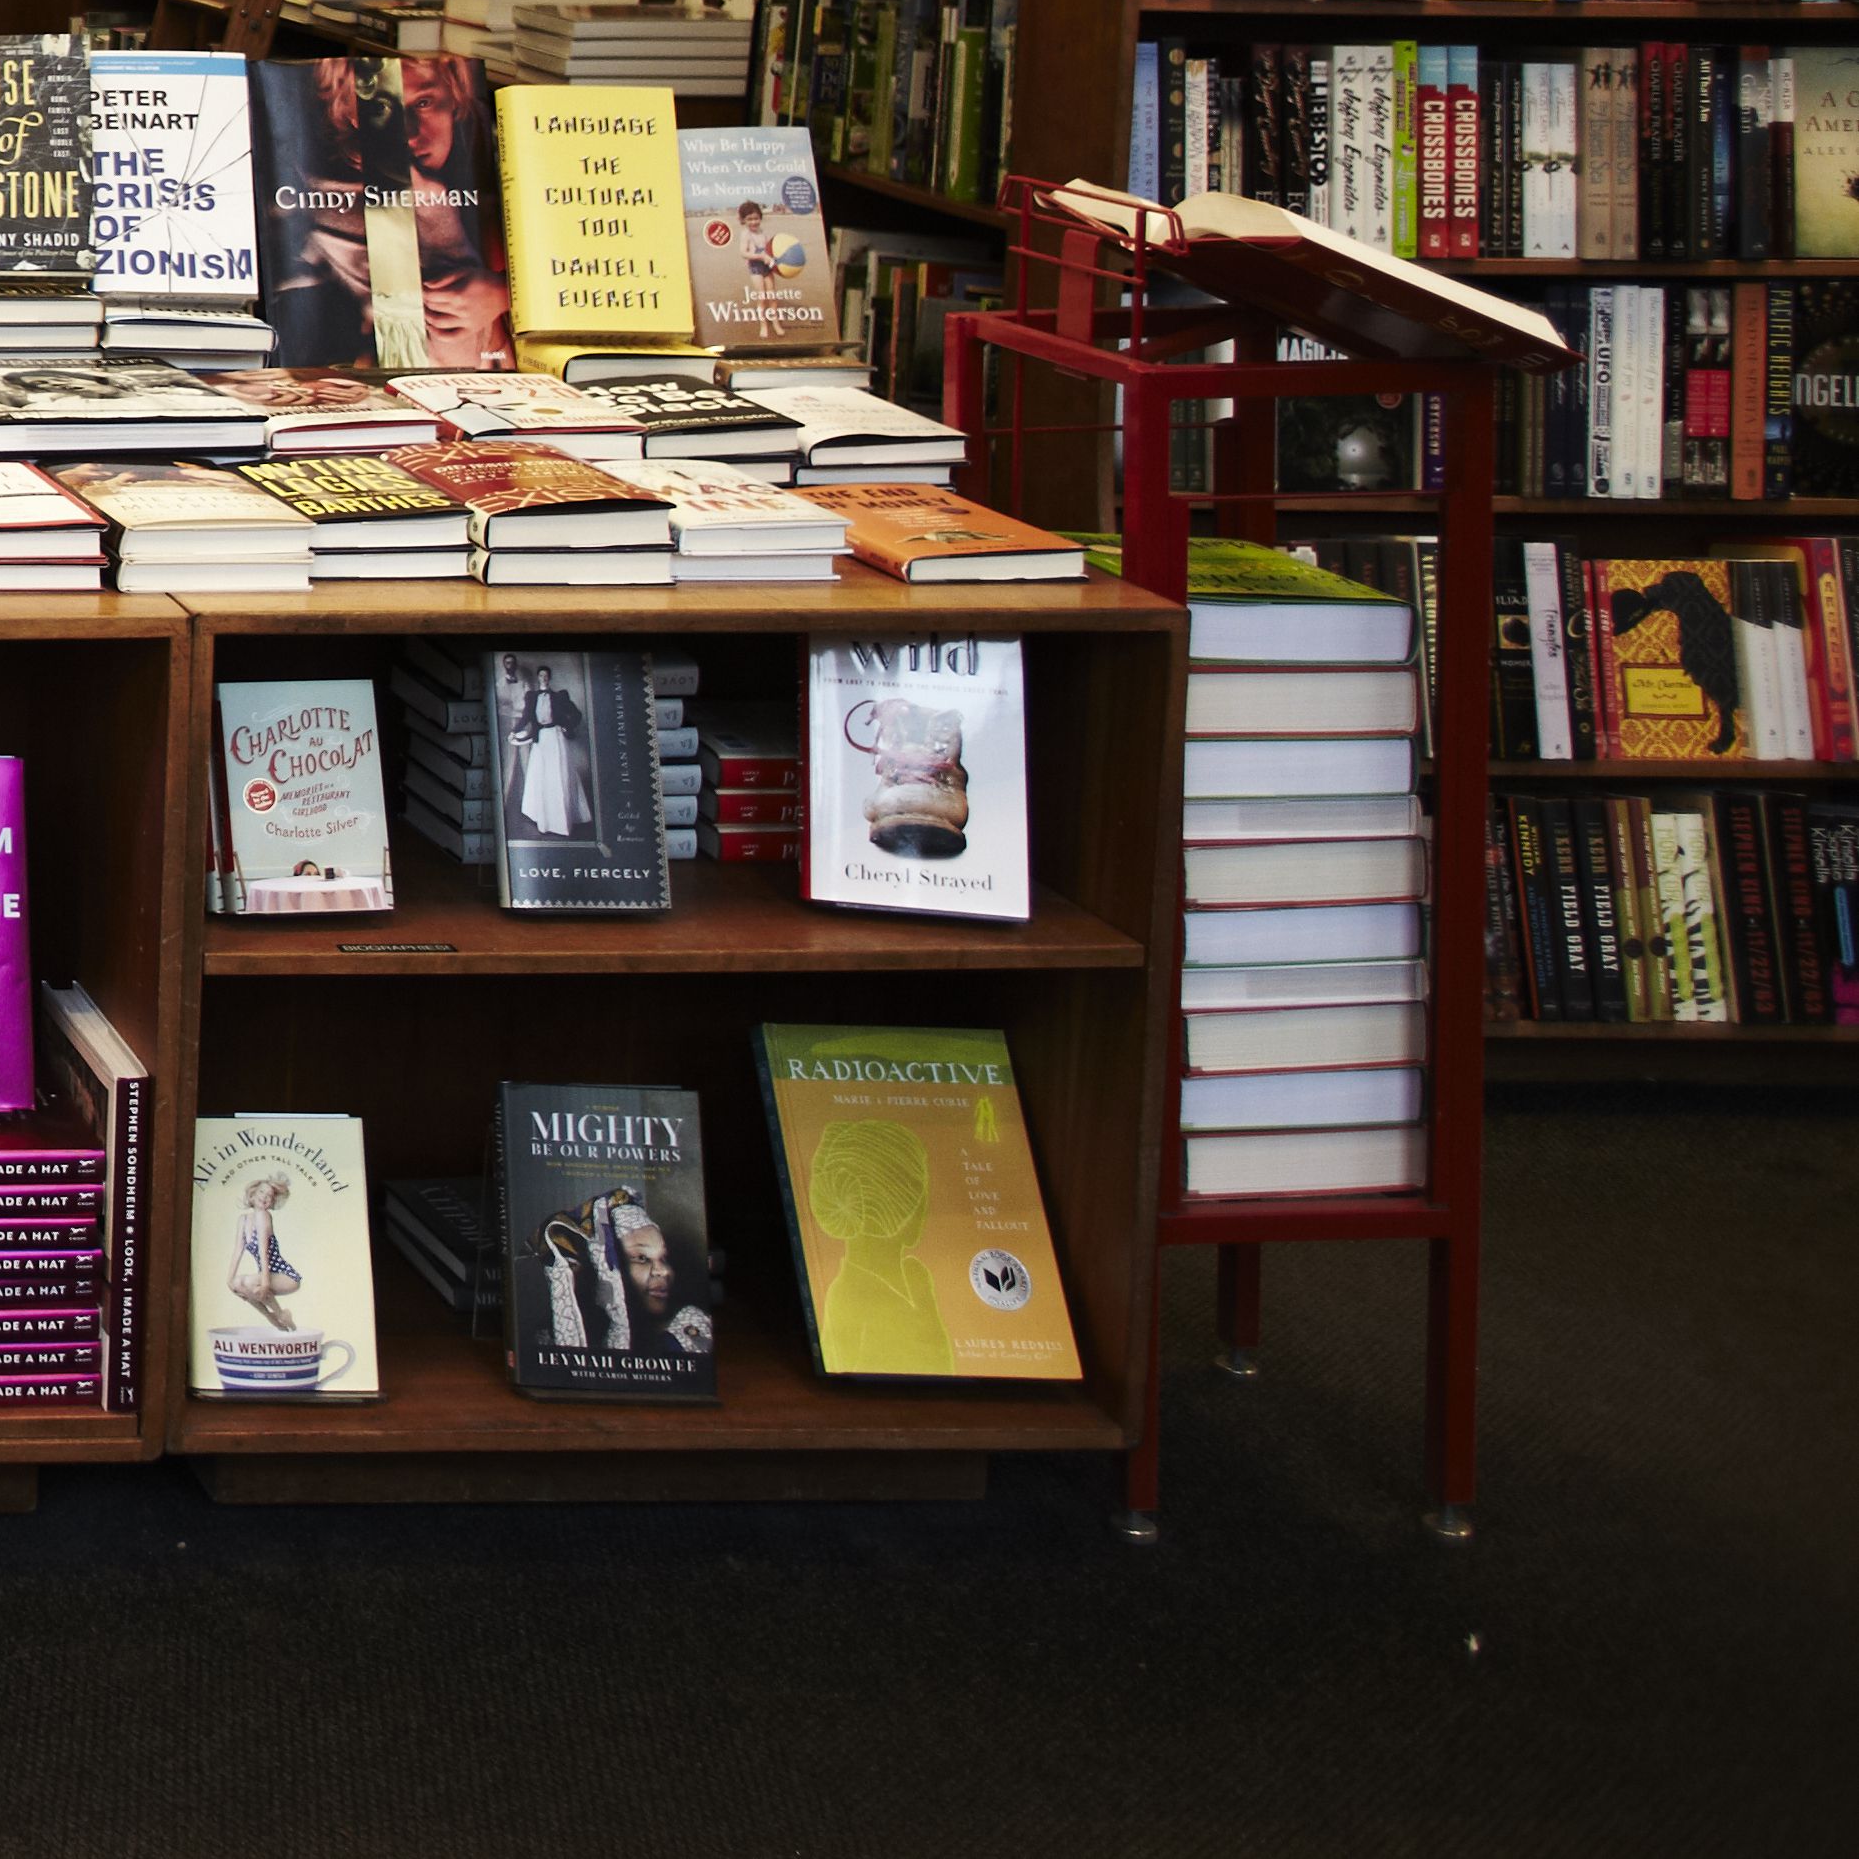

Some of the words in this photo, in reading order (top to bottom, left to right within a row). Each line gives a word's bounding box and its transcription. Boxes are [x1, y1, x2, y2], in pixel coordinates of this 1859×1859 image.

[91, 113, 199, 131] BEINART
[535, 116, 657, 136] LANGUAGE
[0, 111, 47, 162] of
[93, 150, 165, 176] THE
[580, 156, 620, 176] THE
[1423, 99, 1445, 220] CROSSBONES
[93, 179, 216, 211] CRISIS
[545, 187, 659, 208] CULTURAL
[93, 216, 141, 241] OF
[579, 218, 633, 238] TOOL
[23, 231, 80, 248] SHADID
[95, 249, 253, 282] ZIONISM
[552, 258, 640, 278] DANIEL
[649, 258, 667, 279] L.
[742, 286, 802, 305] Jeanette
[707, 301, 823, 323] Winterson
[787, 1058, 1003, 1086] RADIOACTIVE
[532, 1112, 683, 1148] MIGHTY
[531, 1143, 553, 1157] BE
[557, 1144, 591, 1159] OUR
[598, 1145, 681, 1164] POWERS
